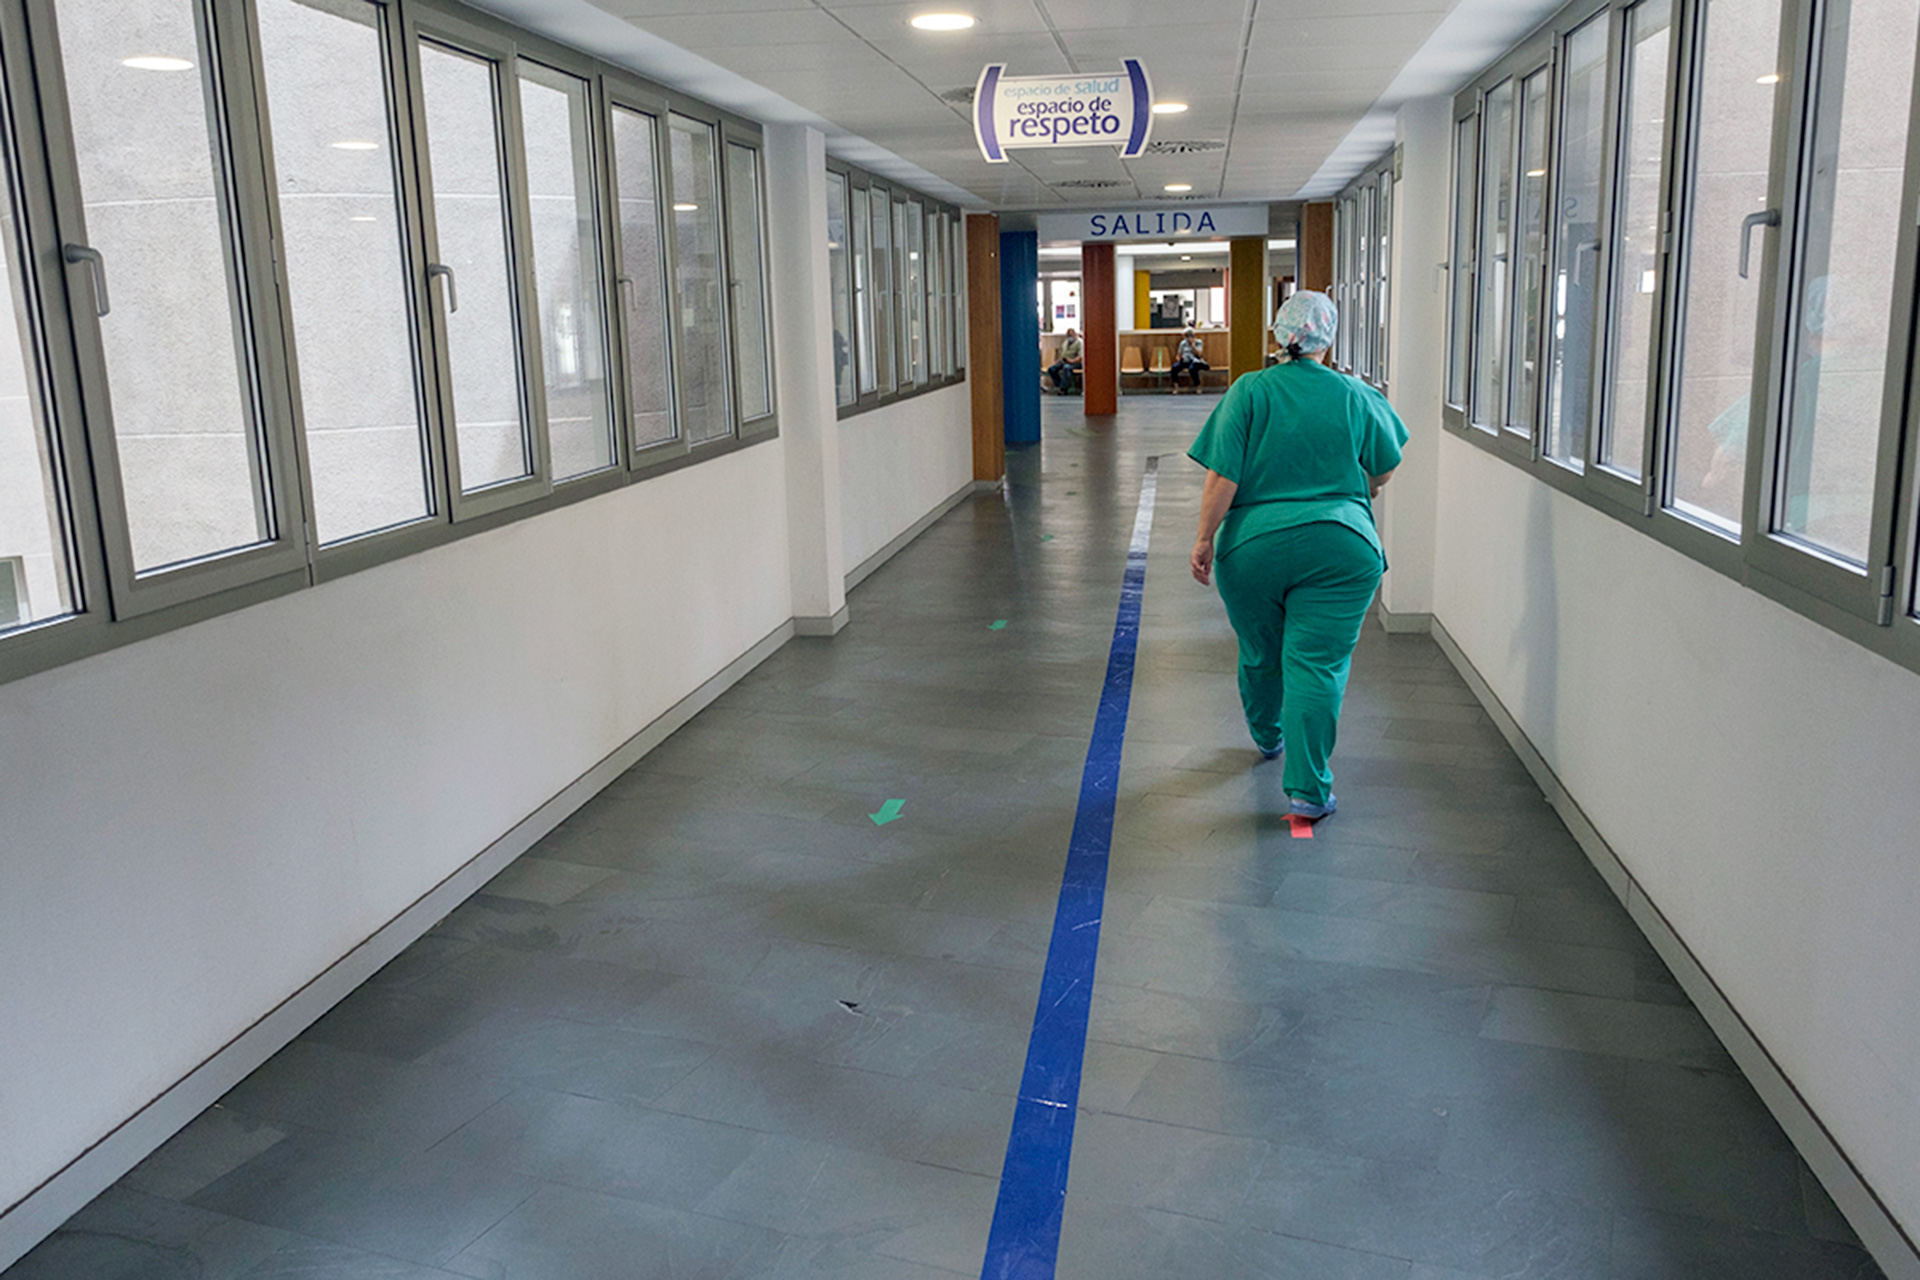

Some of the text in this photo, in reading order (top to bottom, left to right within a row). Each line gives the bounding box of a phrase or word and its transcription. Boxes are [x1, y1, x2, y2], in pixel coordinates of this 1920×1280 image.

[1004, 78, 1120, 99] espacio de salud
[1017, 96, 1111, 118] espacio de
[1009, 112, 1120, 144] respeto
[1091, 211, 1216, 236] SALIDA
